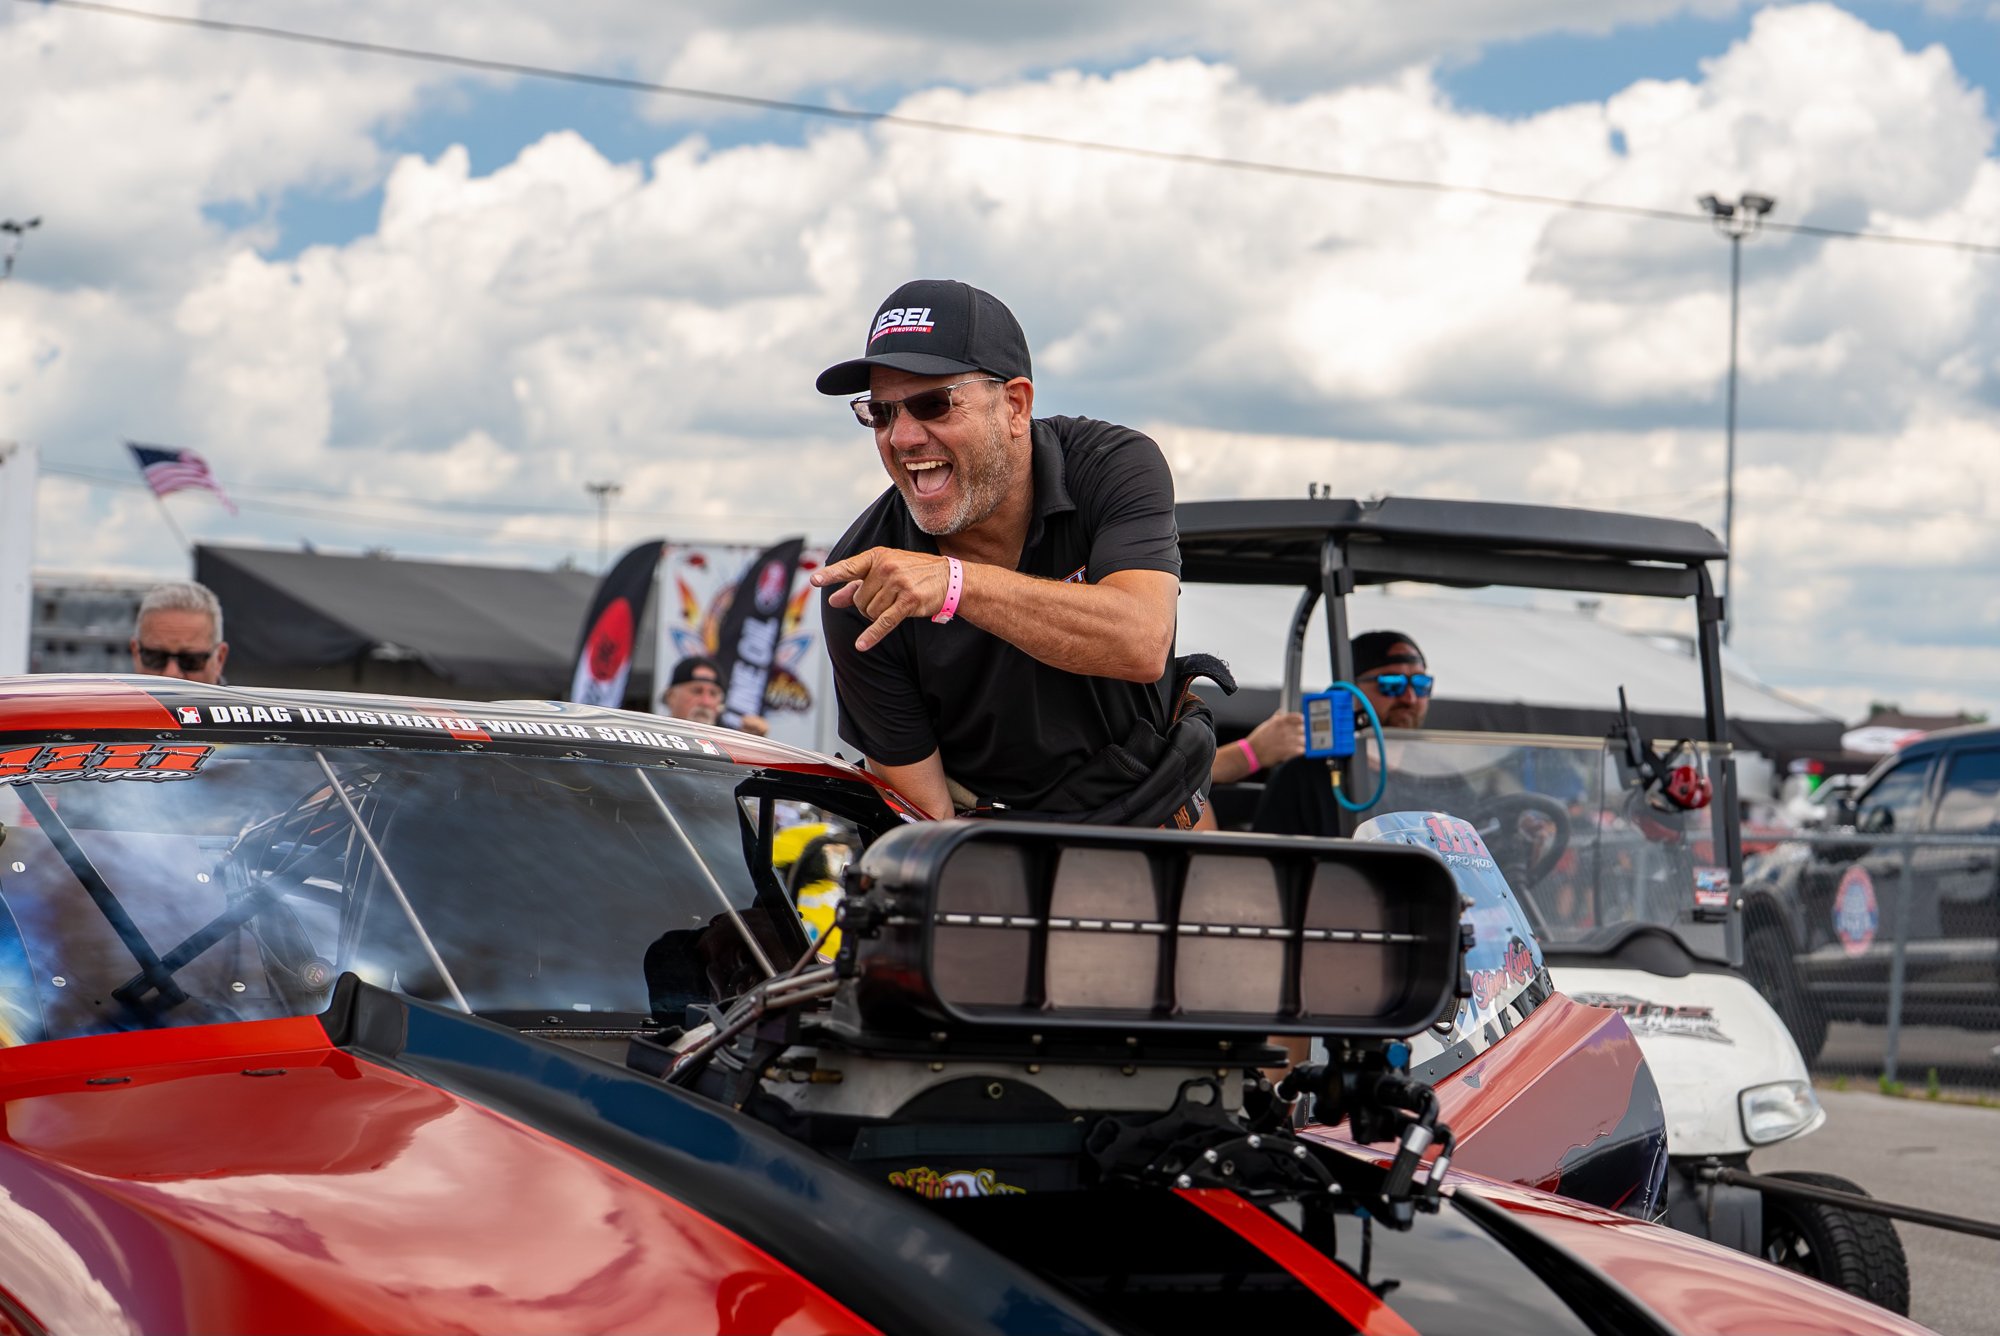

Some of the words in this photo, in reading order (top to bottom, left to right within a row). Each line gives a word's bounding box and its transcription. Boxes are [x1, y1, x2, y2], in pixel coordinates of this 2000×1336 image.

[872, 307, 935, 337] JESEL
[209, 706, 293, 723] DRAG
[299, 707, 479, 732] ILLUSTRATED
[482, 718, 591, 739] WINTER
[594, 725, 690, 751] SERIES
[1446, 854, 1470, 866] PRO
[1471, 857, 1493, 869] MOD
